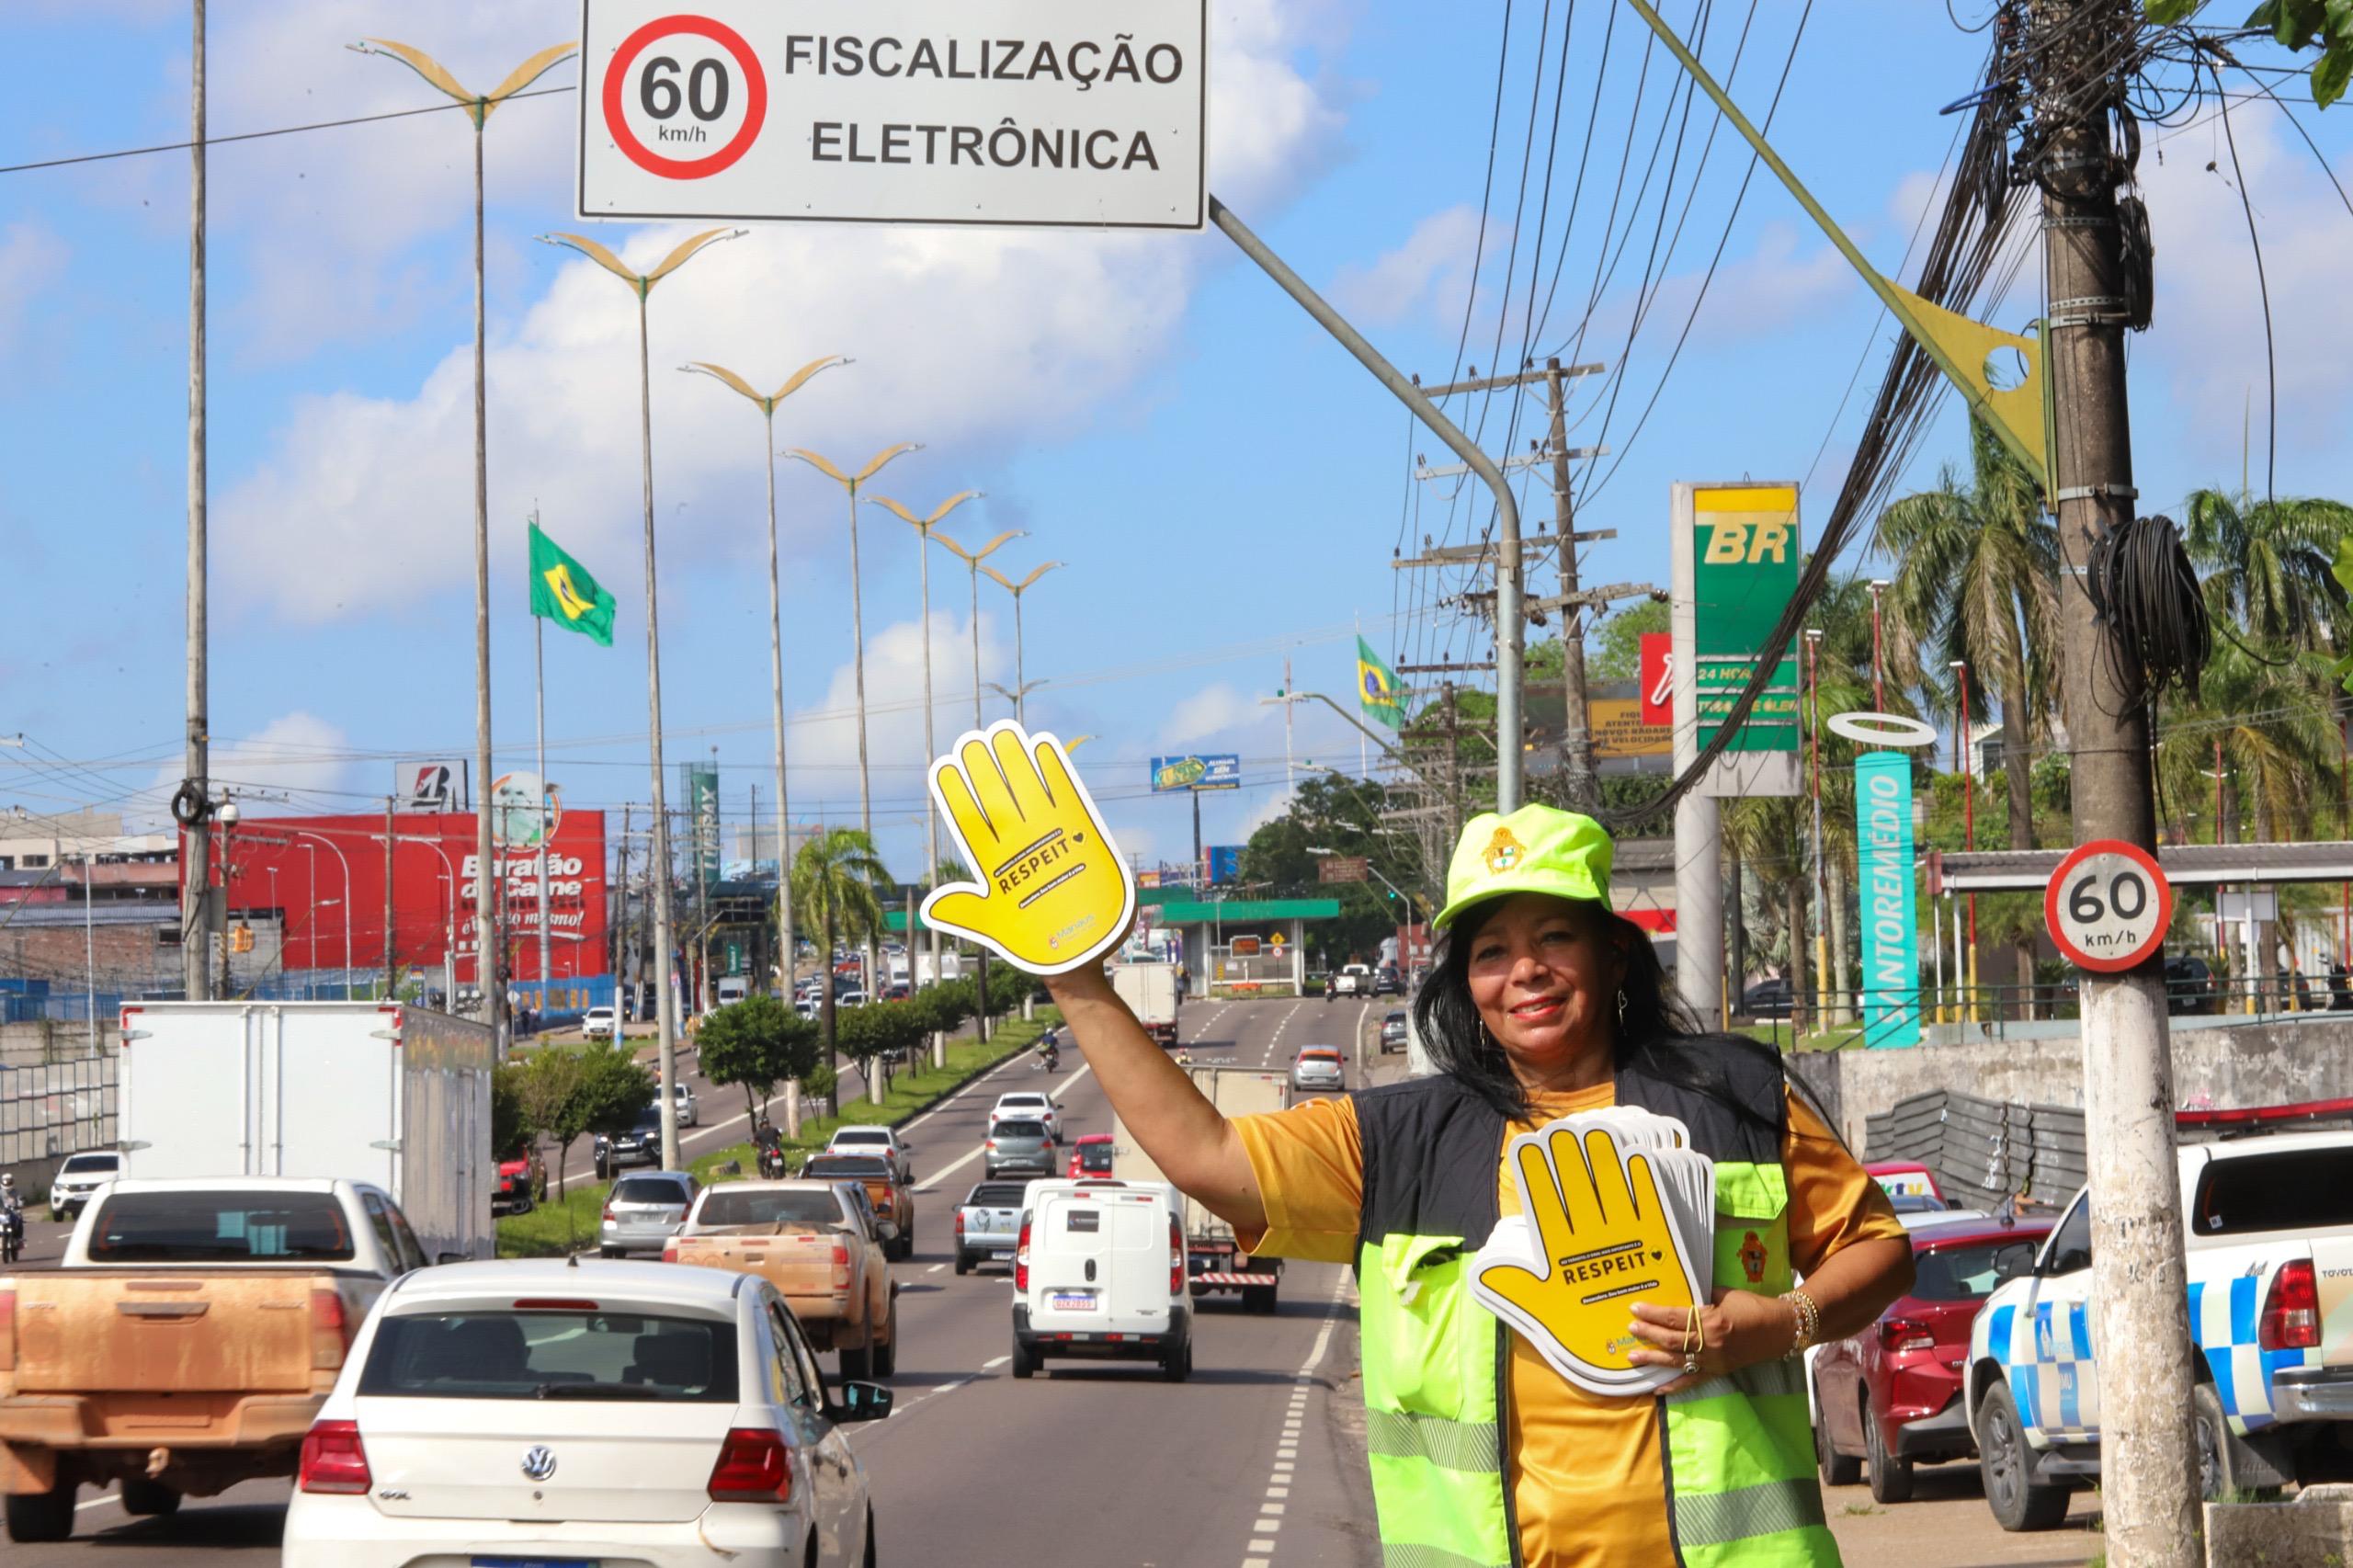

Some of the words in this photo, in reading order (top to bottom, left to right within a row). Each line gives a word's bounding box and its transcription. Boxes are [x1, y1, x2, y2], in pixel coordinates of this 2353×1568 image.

[784, 33, 1183, 91] FISCALIZAÇÃO
[639, 56, 730, 121] 60
[658, 125, 708, 142] km/h
[812, 118, 1160, 171] ELETRÔNICA
[1704, 523, 1789, 564] BR
[1697, 668, 1716, 680] 24
[1720, 668, 1752, 680] HOR
[1698, 700, 1733, 713] TROC
[1631, 726, 1672, 734] RADARE
[460, 854, 583, 878] Bratão
[998, 838, 1069, 894] RESPEIT
[506, 878, 583, 897] Cane
[2069, 871, 2146, 924] 60
[524, 911, 585, 927] msmo!
[2086, 930, 2136, 947] km/h
[1563, 1252, 1645, 1285] RESPEIT
[2322, 1268, 2353, 1278] TOYOT
